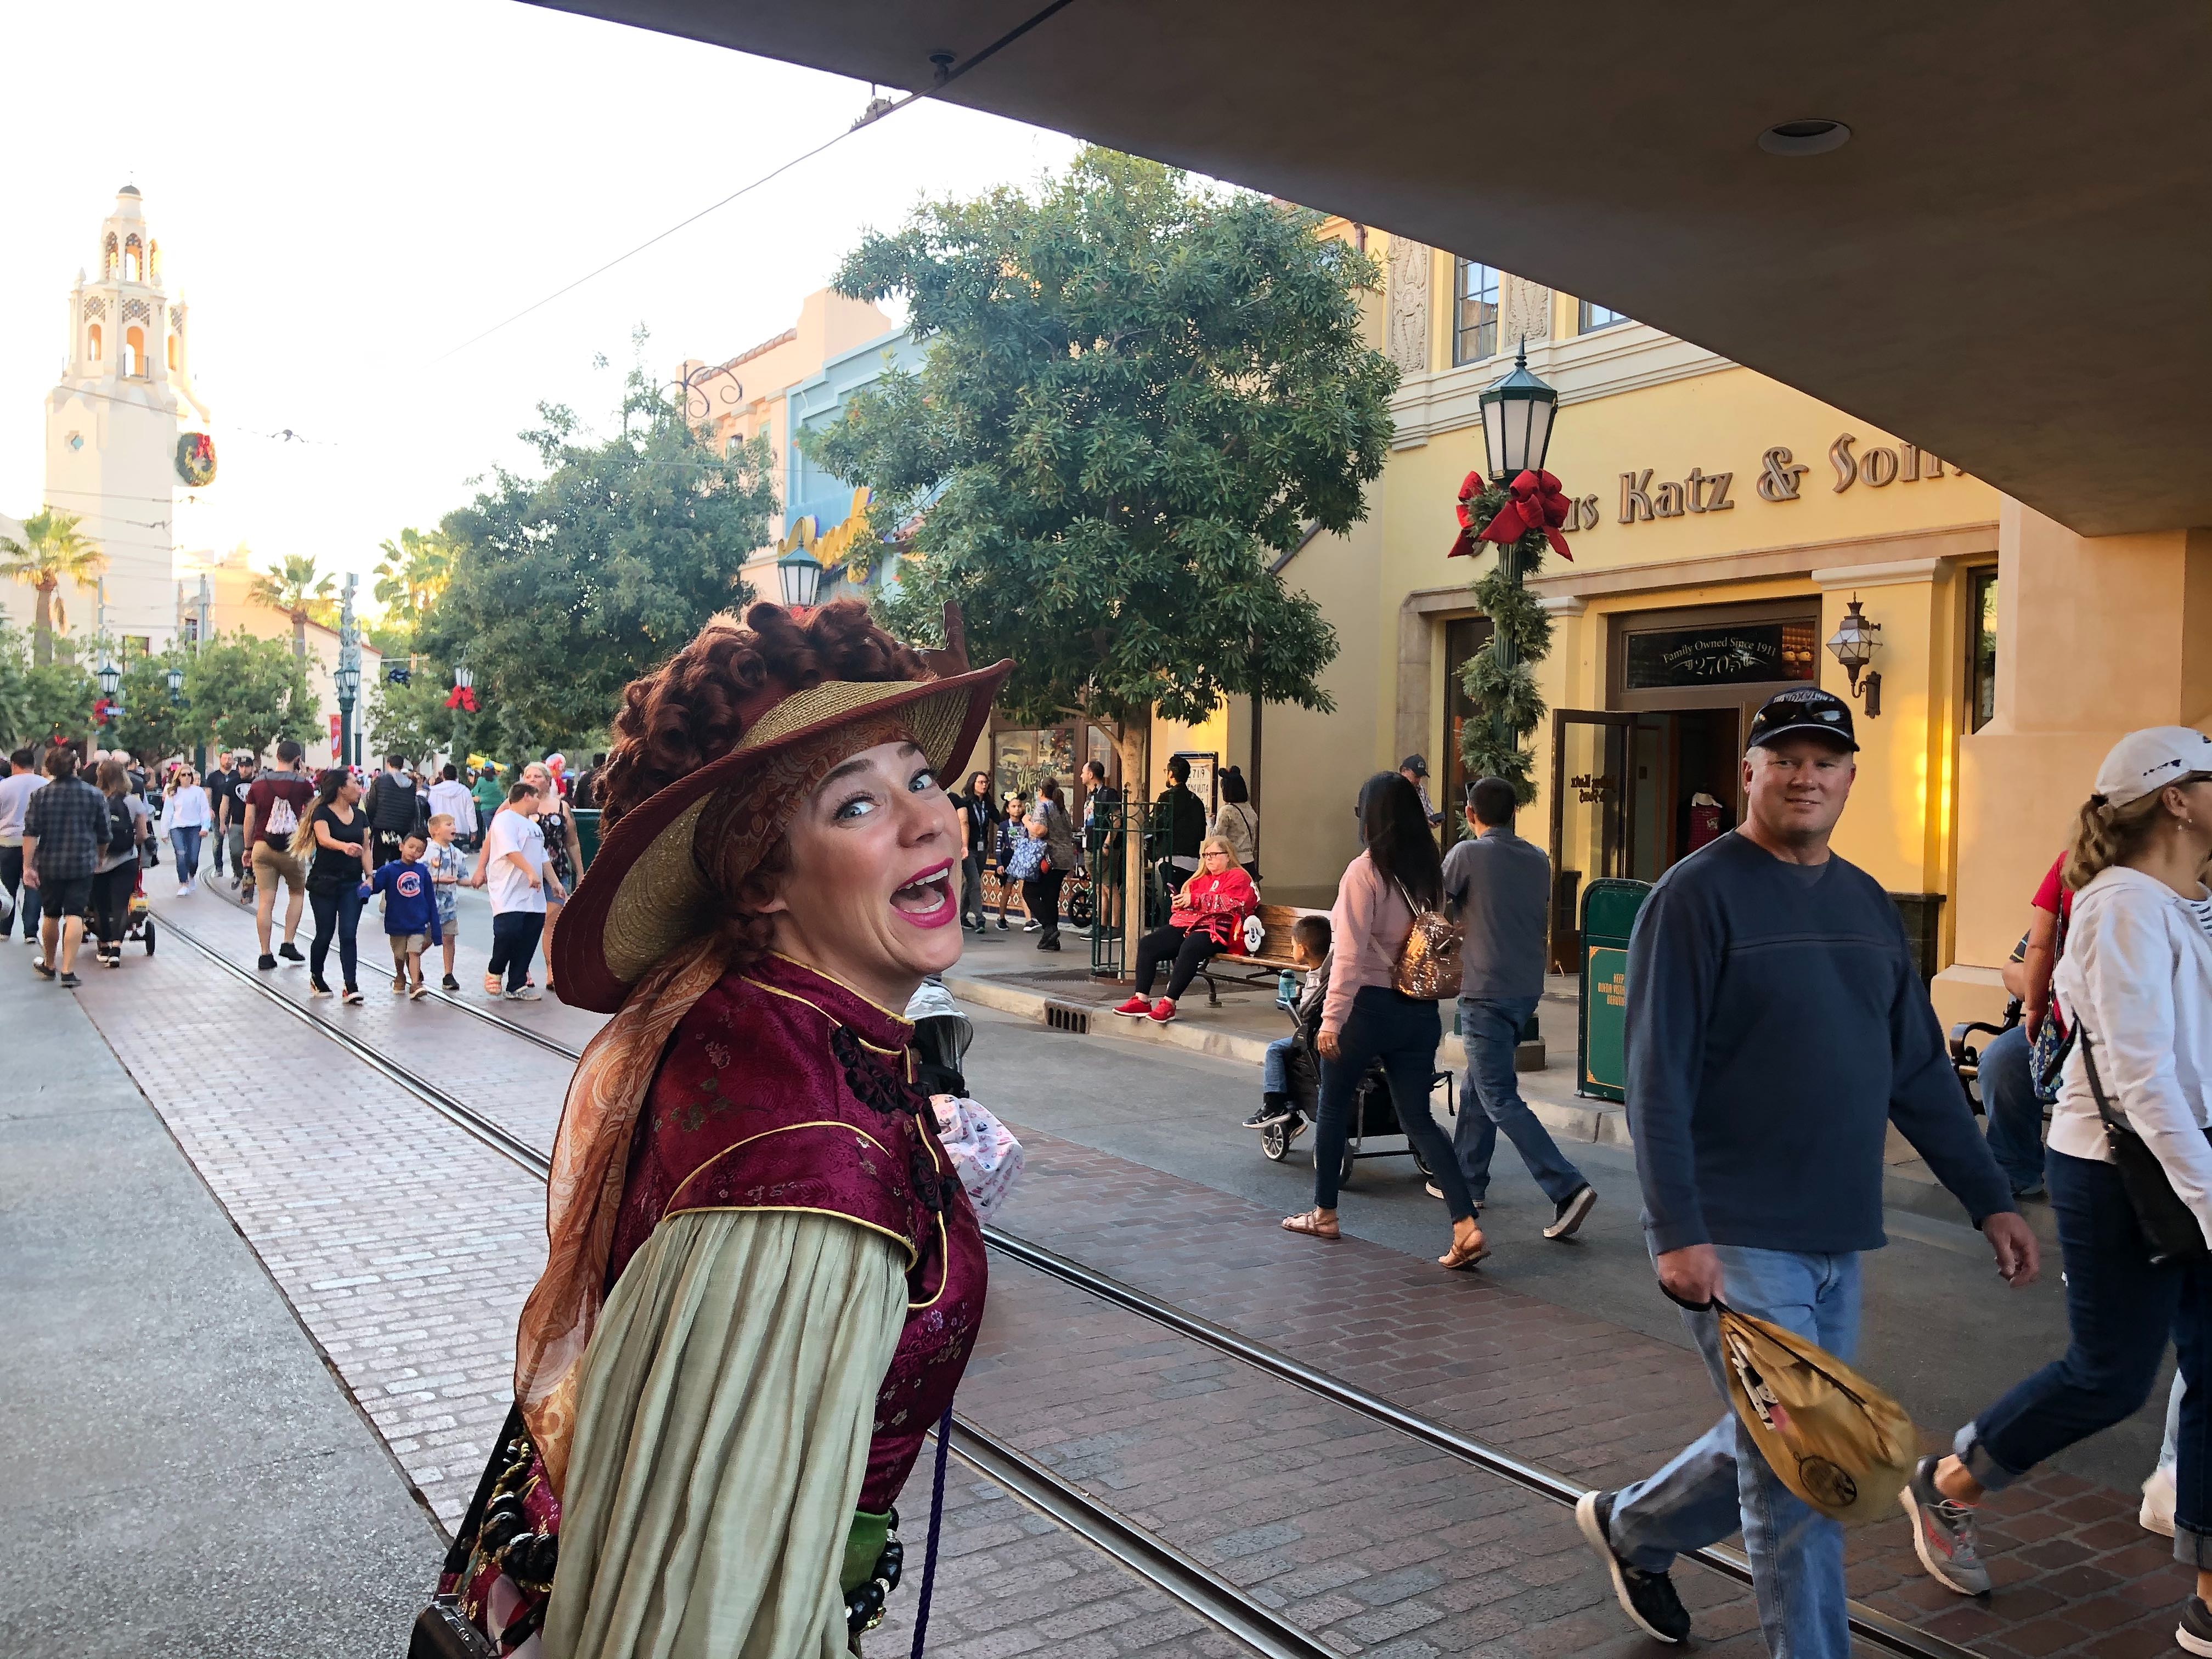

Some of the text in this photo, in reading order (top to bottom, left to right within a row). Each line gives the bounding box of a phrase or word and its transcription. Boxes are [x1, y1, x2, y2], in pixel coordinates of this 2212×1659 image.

[1618, 467, 1734, 524] Katz
[1757, 447, 1809, 502] &
[1829, 432, 1965, 494] Son
[1663, 637, 1776, 663] Family Owned Since 1911
[1189, 769, 1205, 778] 719
[1613, 973, 1624, 984] KEEP
[1598, 982, 1612, 994] BUENA
